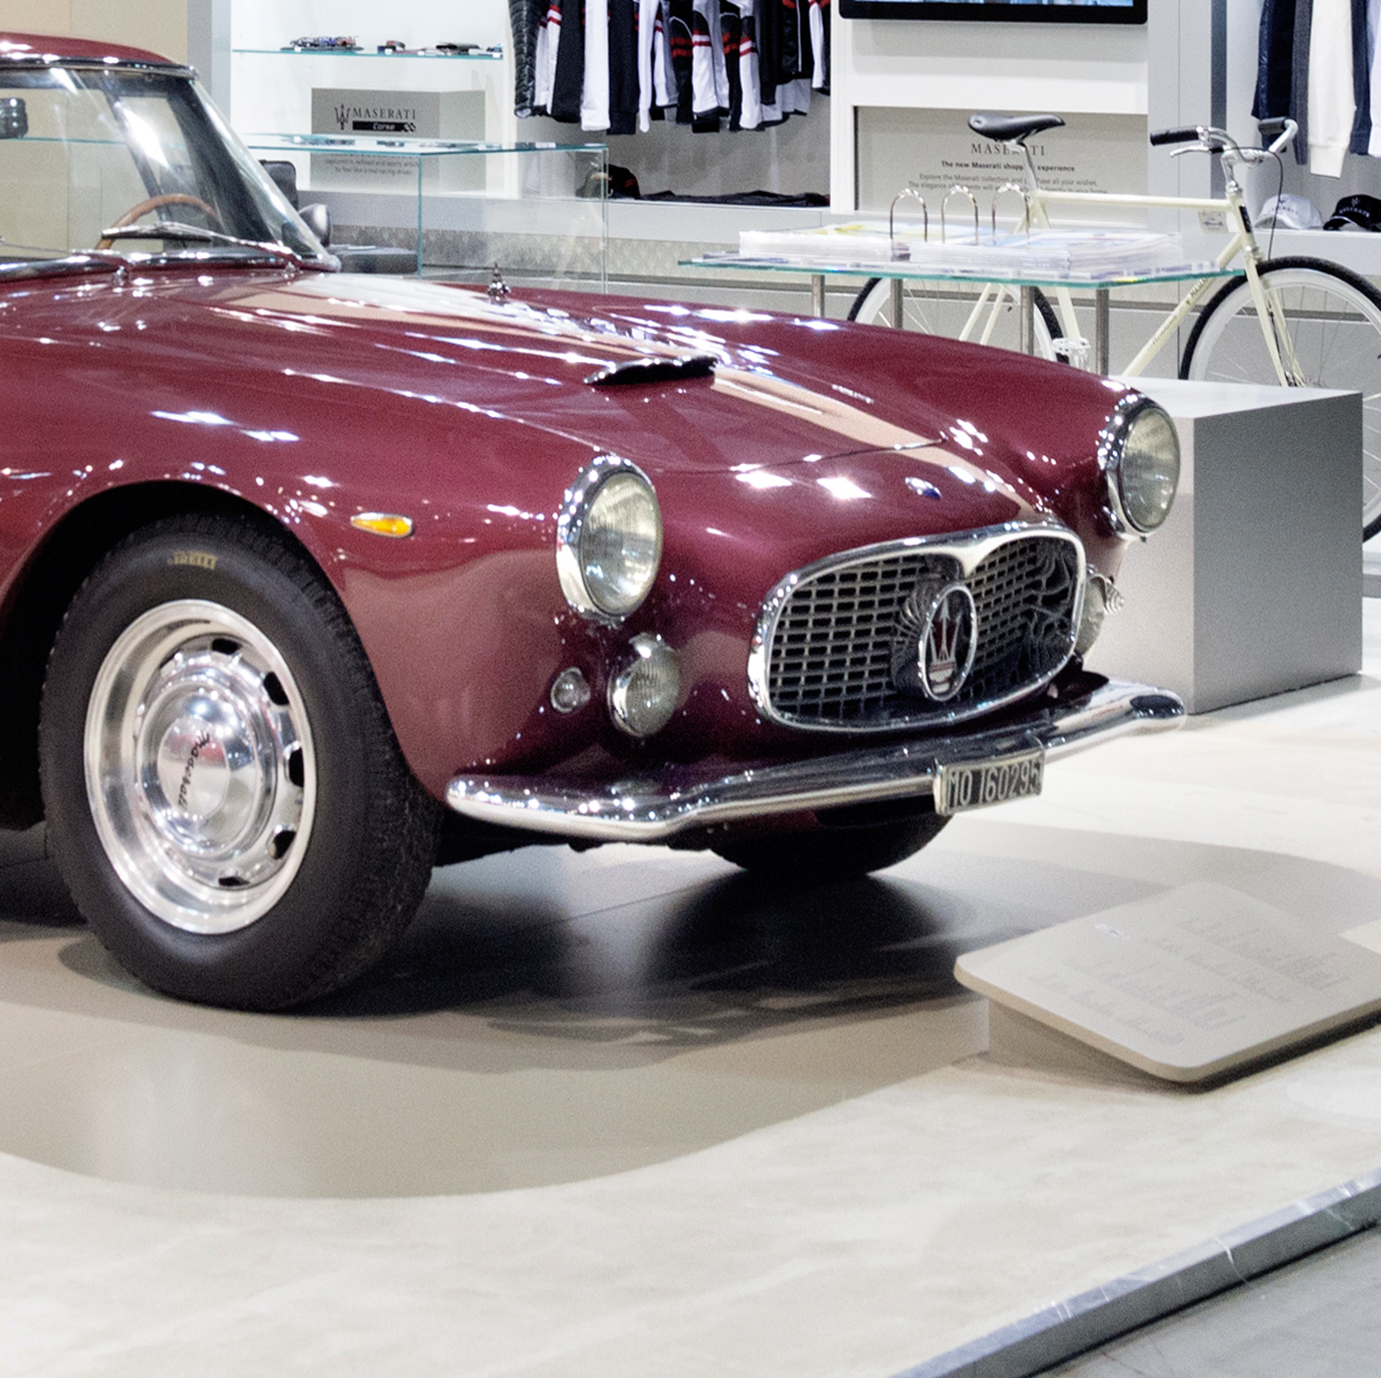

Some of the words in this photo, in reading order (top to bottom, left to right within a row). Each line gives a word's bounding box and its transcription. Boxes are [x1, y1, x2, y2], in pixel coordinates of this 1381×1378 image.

[352, 107, 417, 120] MASERATI
[970, 143, 1045, 156] MASETI
[941, 160, 954, 168] The
[971, 162, 1002, 170] Maserati
[1003, 163, 1024, 171] shopp
[1037, 164, 1075, 172] experience
[946, 768, 973, 810] MO
[978, 759, 1041, 804] 160295
